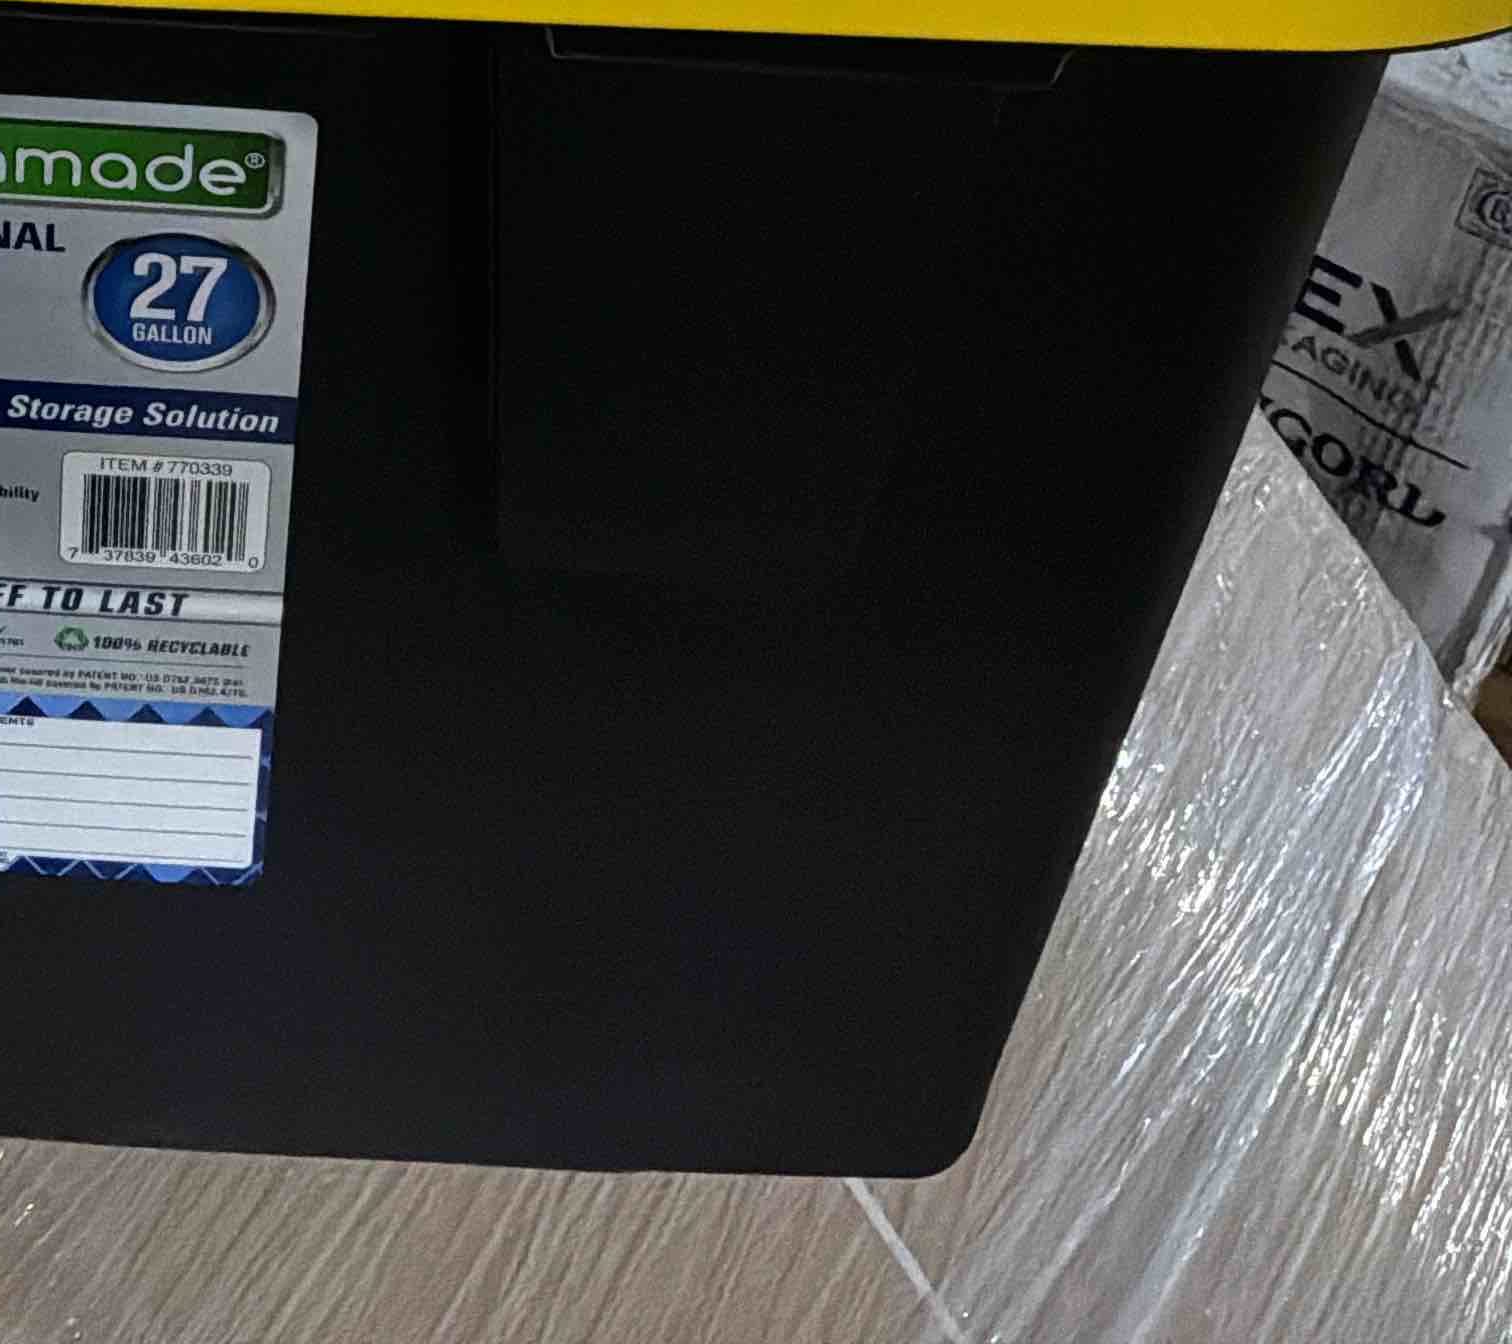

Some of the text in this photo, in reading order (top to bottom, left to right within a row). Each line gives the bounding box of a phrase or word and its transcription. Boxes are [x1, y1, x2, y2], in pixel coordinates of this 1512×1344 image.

[129, 252, 228, 321] 27
[132, 322, 212, 345] GALLON
[8, 394, 134, 428] Storage
[143, 402, 280, 433] Solution
[99, 457, 146, 472] ITEM
[67, 547, 259, 569] 7 37839 43602 0
[41, 585, 85, 612] TO
[98, 589, 190, 617] LAST
[92, 635, 252, 658] 100% RECYCLABLE
